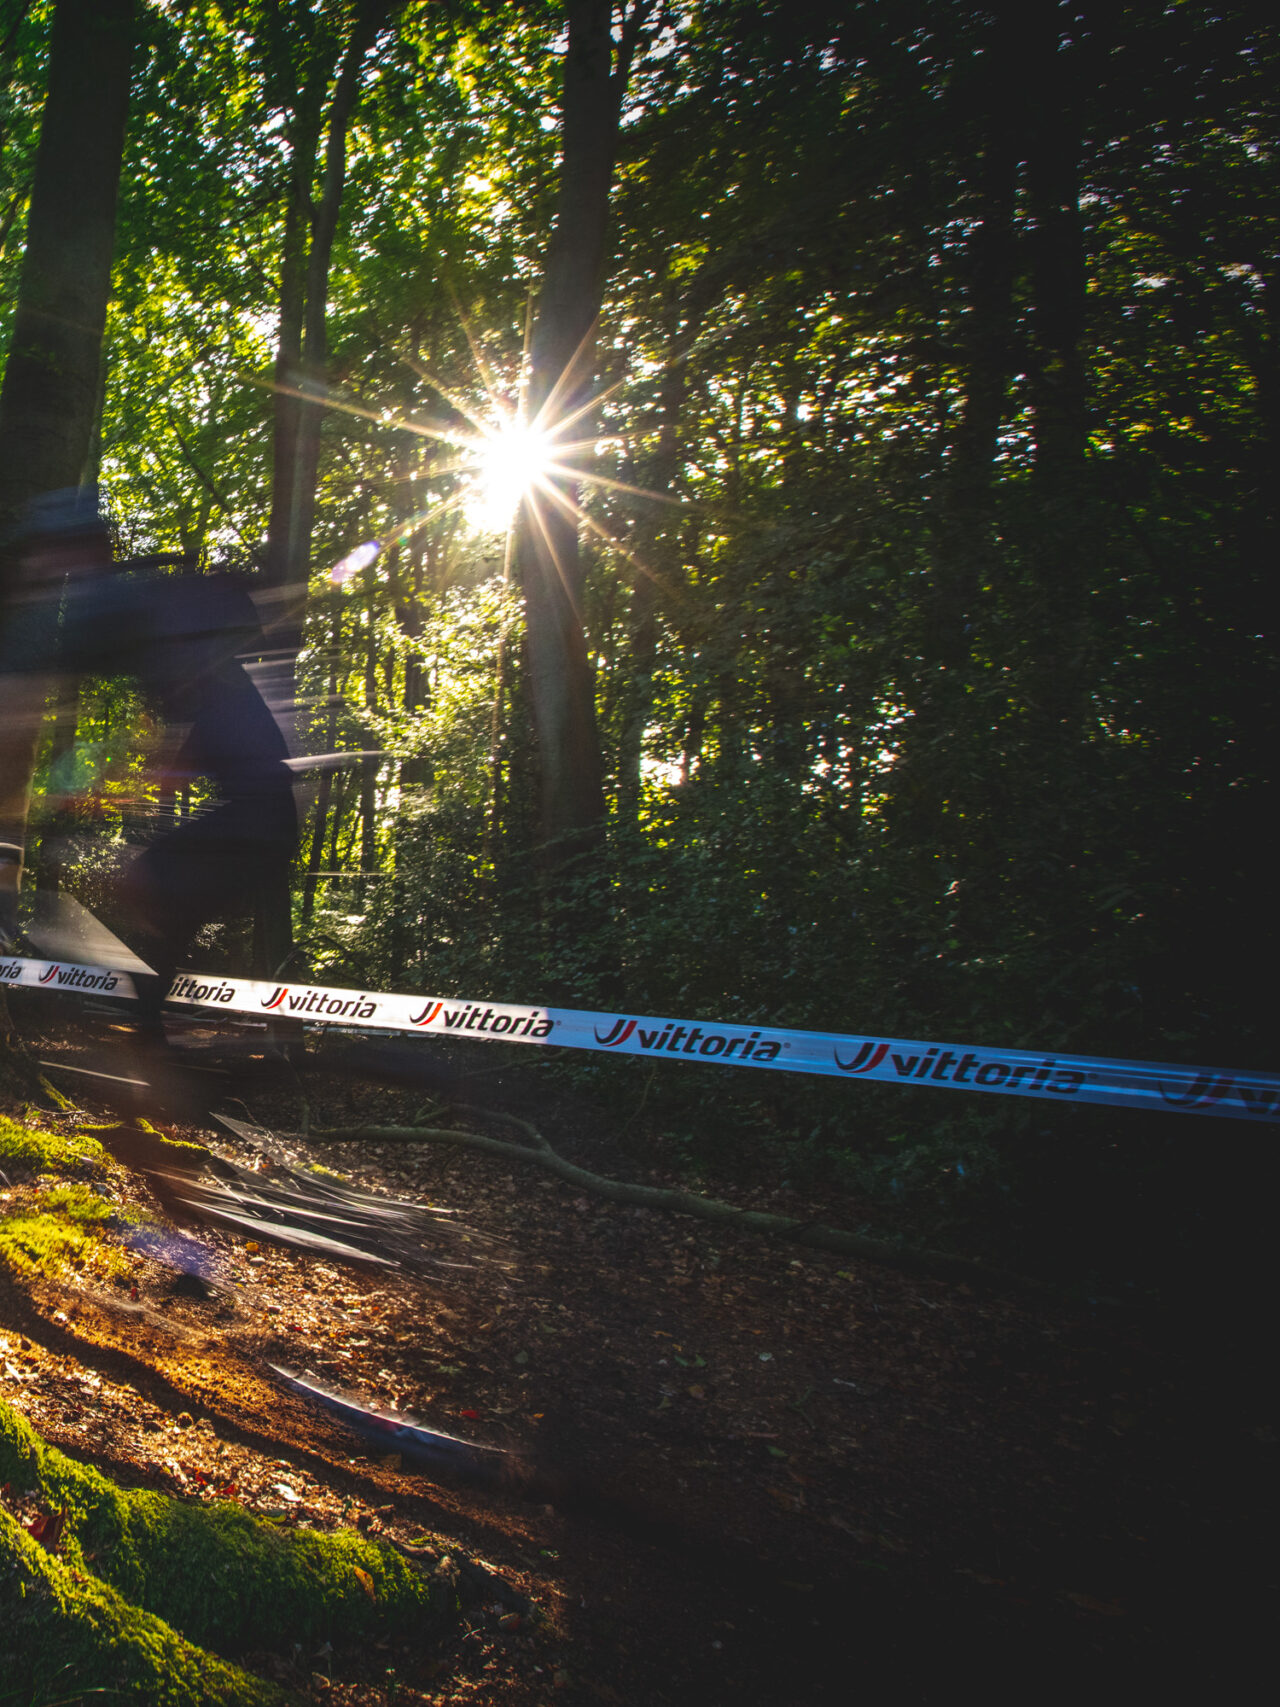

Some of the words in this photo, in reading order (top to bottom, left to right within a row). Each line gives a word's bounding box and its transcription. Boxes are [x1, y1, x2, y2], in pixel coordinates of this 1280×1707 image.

[57, 963, 118, 991] vittoria
[170, 976, 236, 1003] ittoria
[288, 994, 377, 1019] vittoria
[444, 1004, 554, 1039] vittoria
[637, 1023, 783, 1062] vittoria
[890, 1048, 1086, 1095] vittoria
